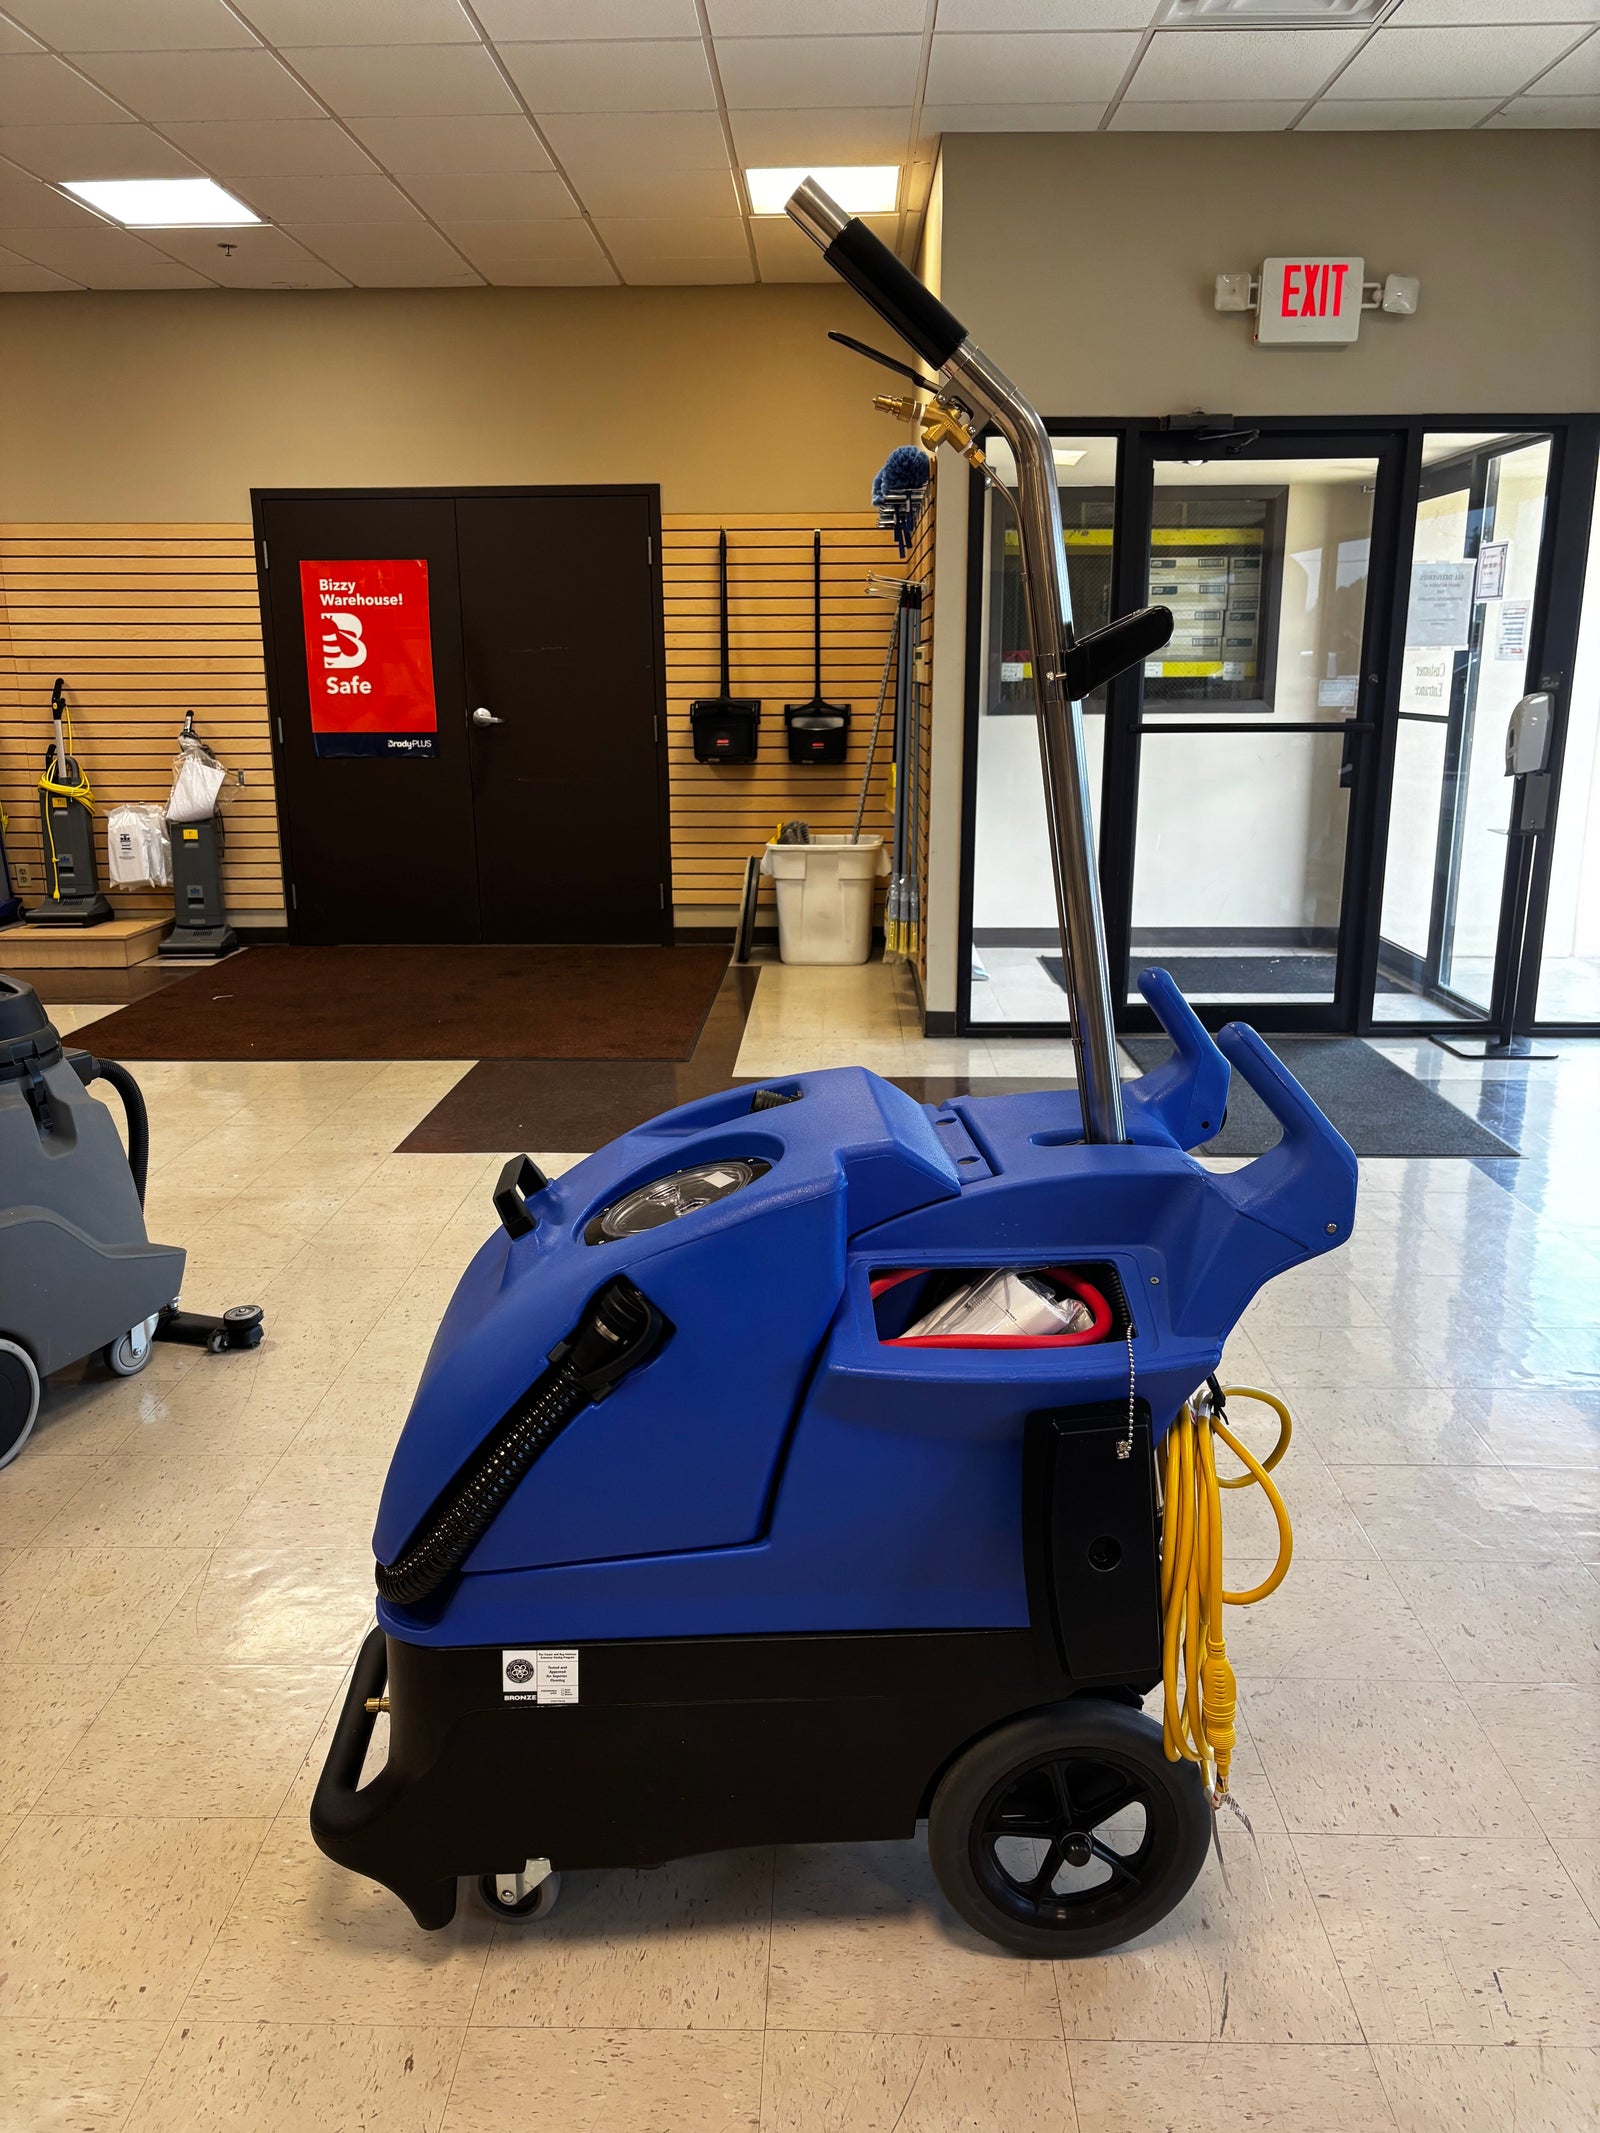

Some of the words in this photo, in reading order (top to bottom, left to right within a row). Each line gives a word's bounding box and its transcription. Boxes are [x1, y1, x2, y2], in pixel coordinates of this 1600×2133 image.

[1281, 264, 1349, 317] EXIT
[319, 578, 356, 594] Bizzy
[320, 593, 403, 606] Warehouse!
[326, 676, 372, 694] Safe
